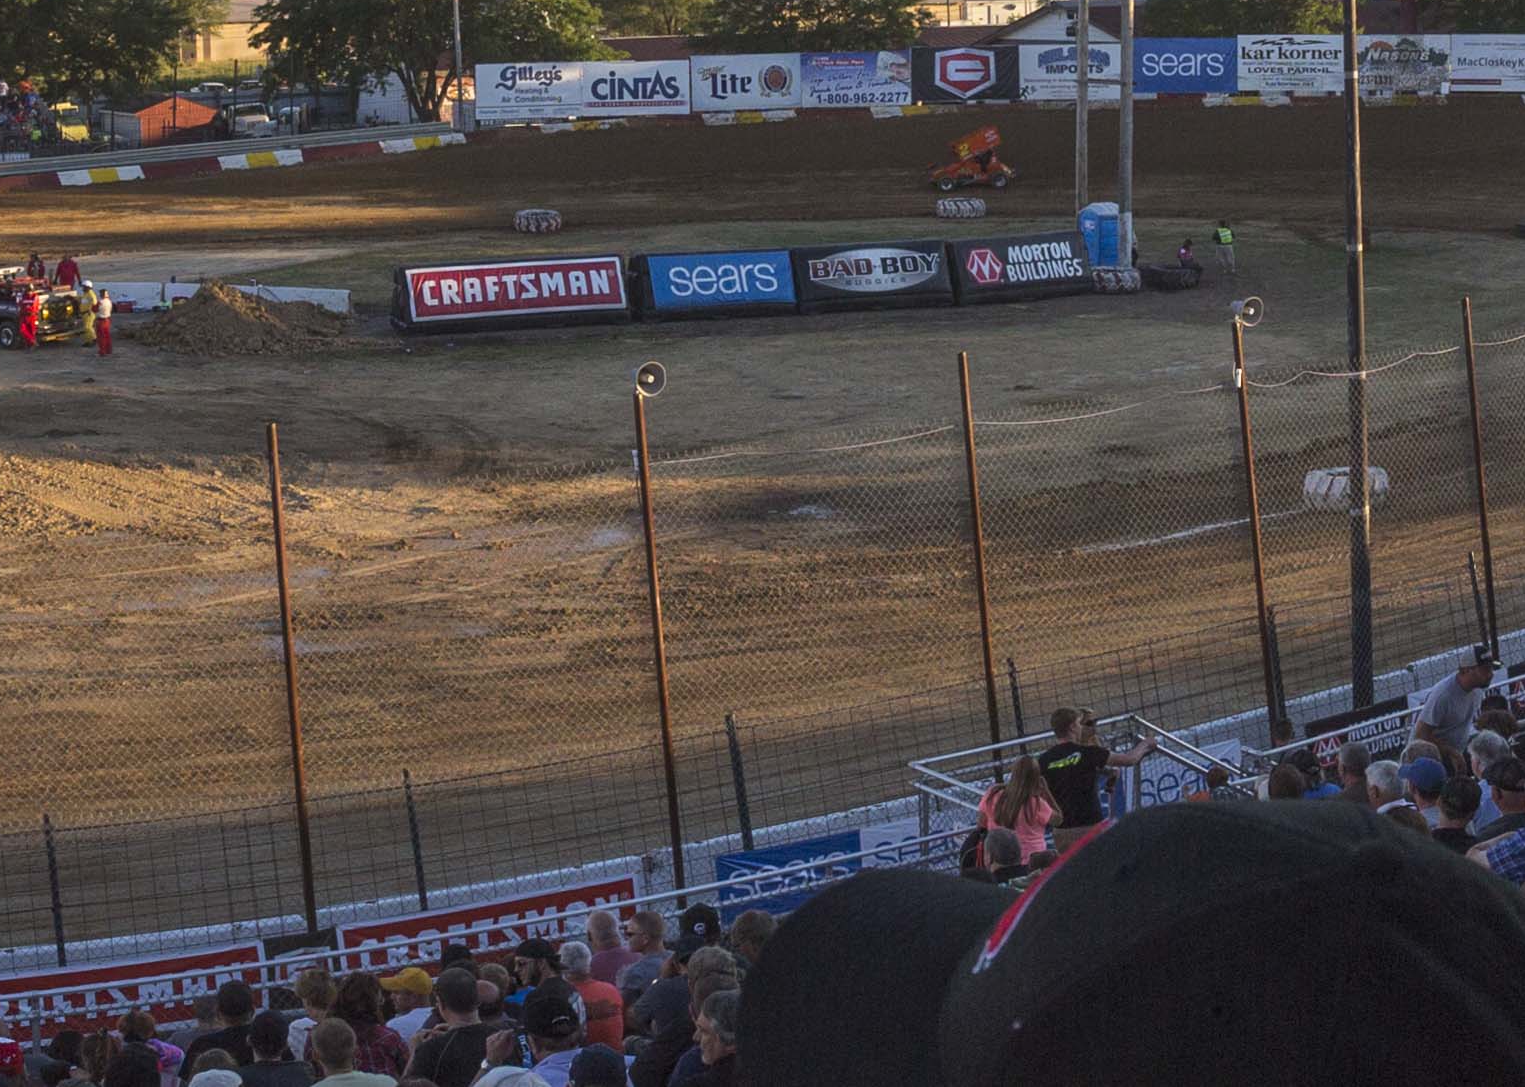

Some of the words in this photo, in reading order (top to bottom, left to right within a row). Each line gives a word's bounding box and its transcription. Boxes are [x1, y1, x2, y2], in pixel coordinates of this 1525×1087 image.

[1142, 53, 1224, 76] sears
[1241, 46, 1274, 60] kar
[1278, 47, 1342, 60] korner
[495, 65, 563, 91] Gilley's
[1045, 65, 1104, 74] IMPOTS
[1248, 66, 1284, 74] LOVES
[710, 73, 752, 100] Lite
[817, 92, 909, 104] 1-800-962-2277
[515, 95, 562, 104] Conditioning
[1007, 241, 1073, 263] MORTON
[669, 261, 778, 297] sears
[809, 259, 873, 282] BAD
[880, 253, 938, 276] BOY
[1005, 258, 1083, 282] BUILDINGS
[422, 269, 611, 306] CRAFTSMAN
